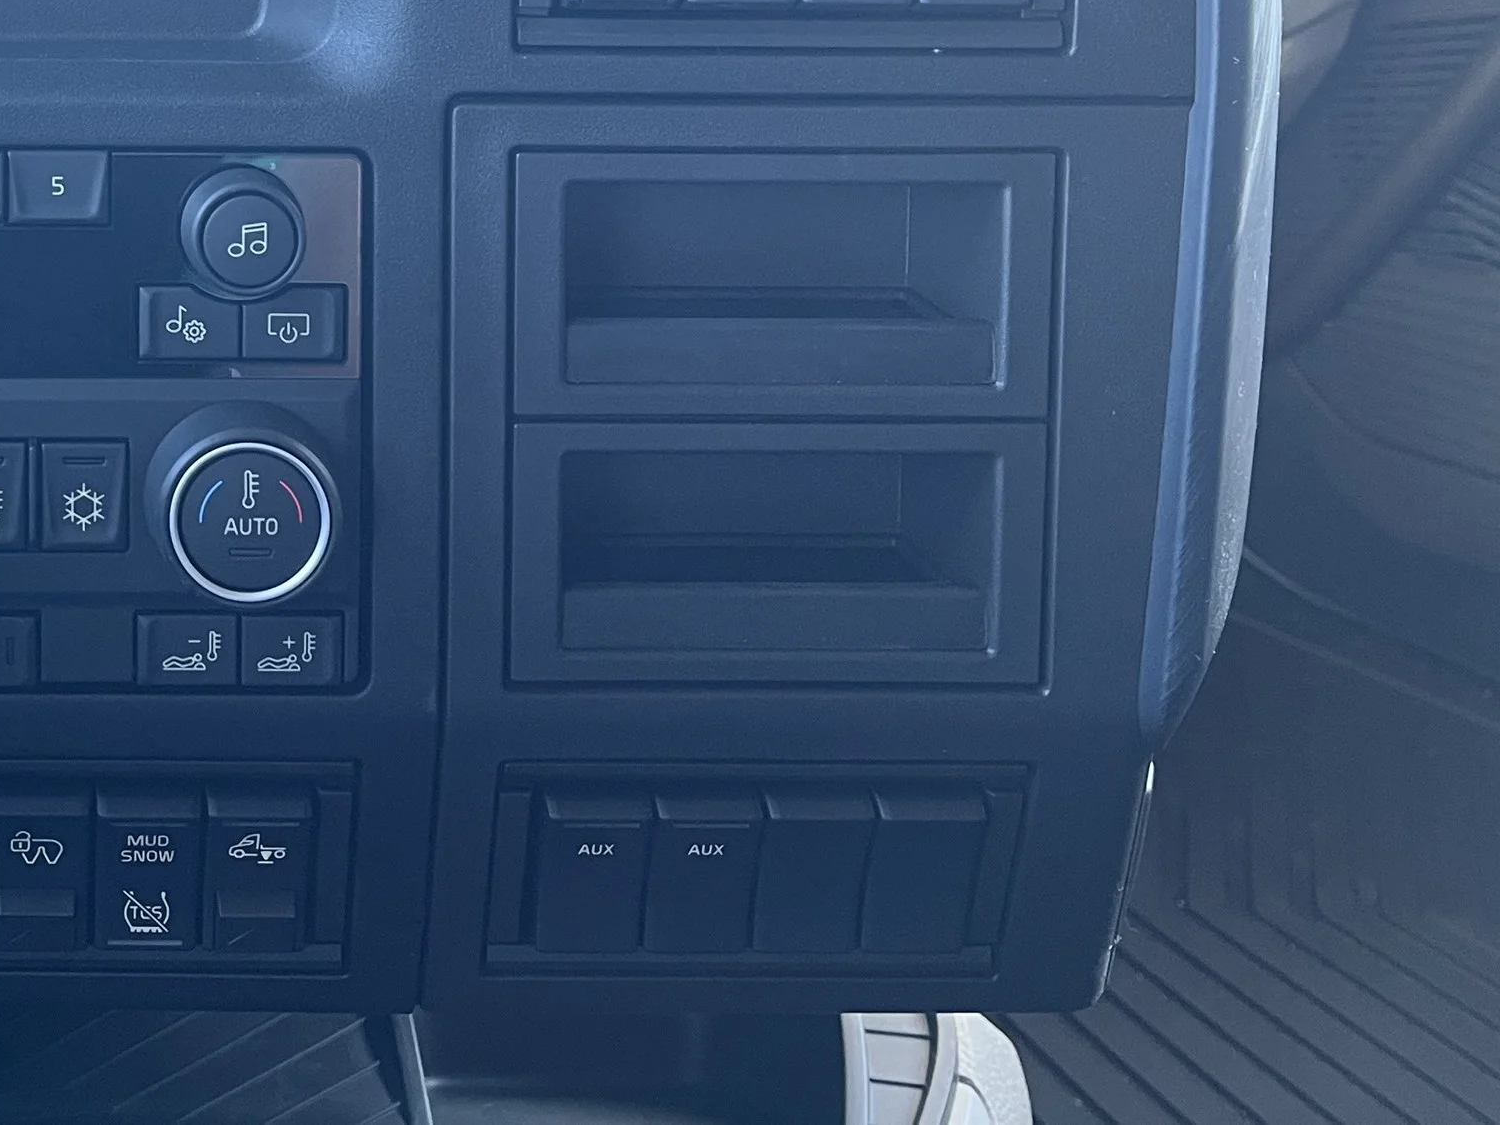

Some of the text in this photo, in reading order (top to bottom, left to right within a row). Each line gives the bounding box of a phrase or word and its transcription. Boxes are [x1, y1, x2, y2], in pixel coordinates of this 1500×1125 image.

[51, 177, 65, 196] 5
[224, 518, 278, 536] AUTO
[127, 835, 170, 847] MUD
[577, 844, 615, 856] AUX
[687, 844, 724, 856] AUX
[121, 850, 175, 863] SNOW
